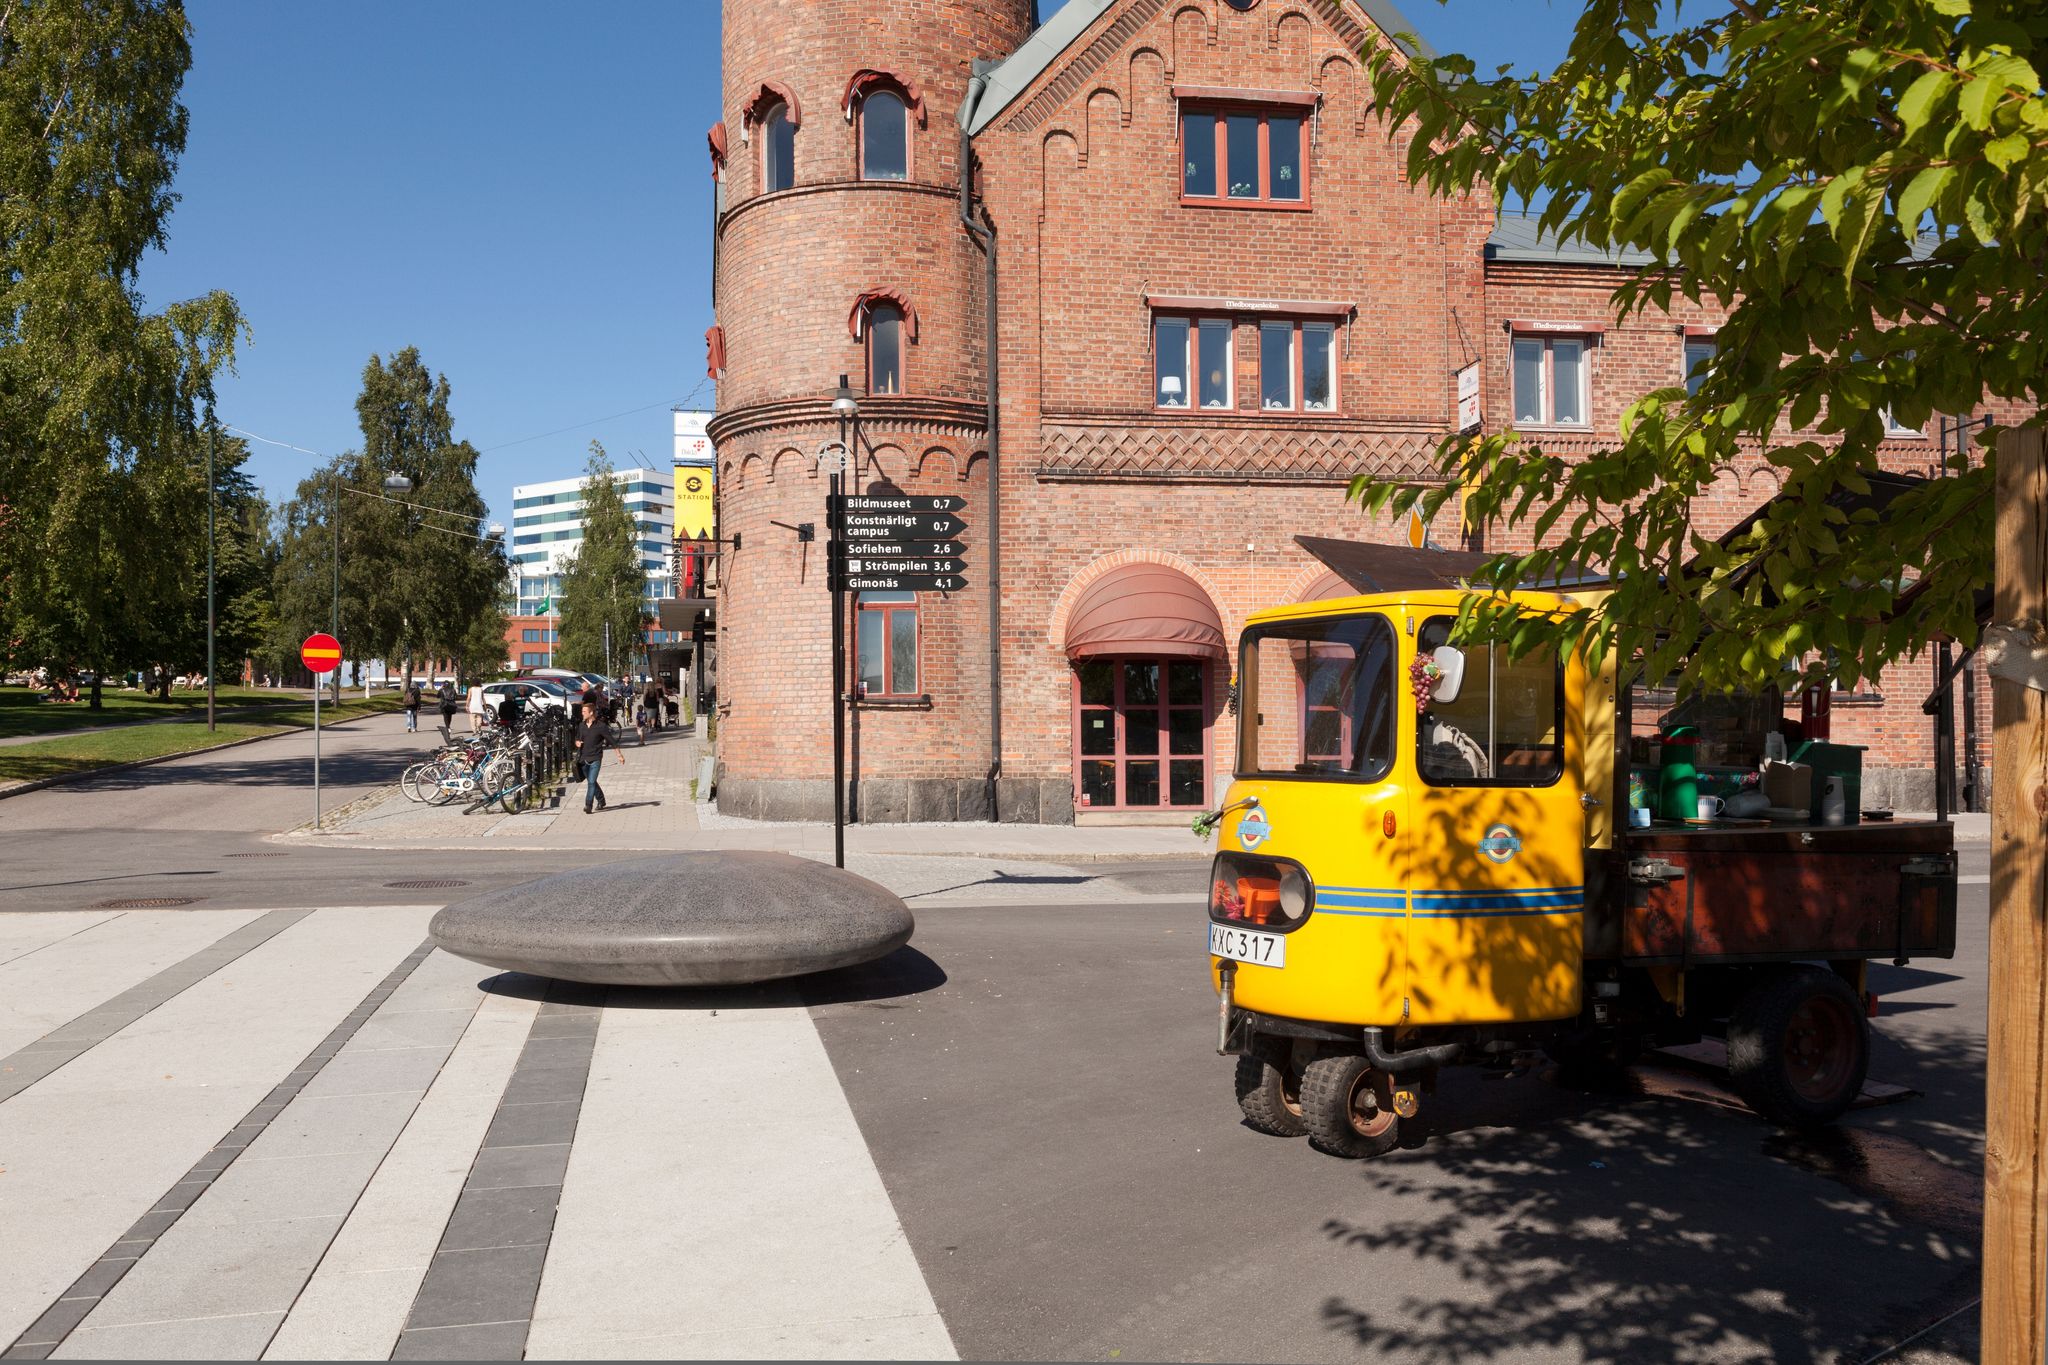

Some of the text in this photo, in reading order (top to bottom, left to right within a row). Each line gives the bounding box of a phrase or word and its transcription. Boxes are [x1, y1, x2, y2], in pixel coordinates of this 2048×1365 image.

[847, 499, 950, 509] Bildmuseet 0,7
[847, 516, 917, 527] Konstnärligt
[847, 522, 949, 537] campus 0,7
[848, 544, 950, 553] Sofiehem 2,6
[865, 561, 951, 572] Strömpilen 3,6
[849, 578, 951, 587] Gimonäs 4,1
[1212, 927, 1275, 961] KXC 317
